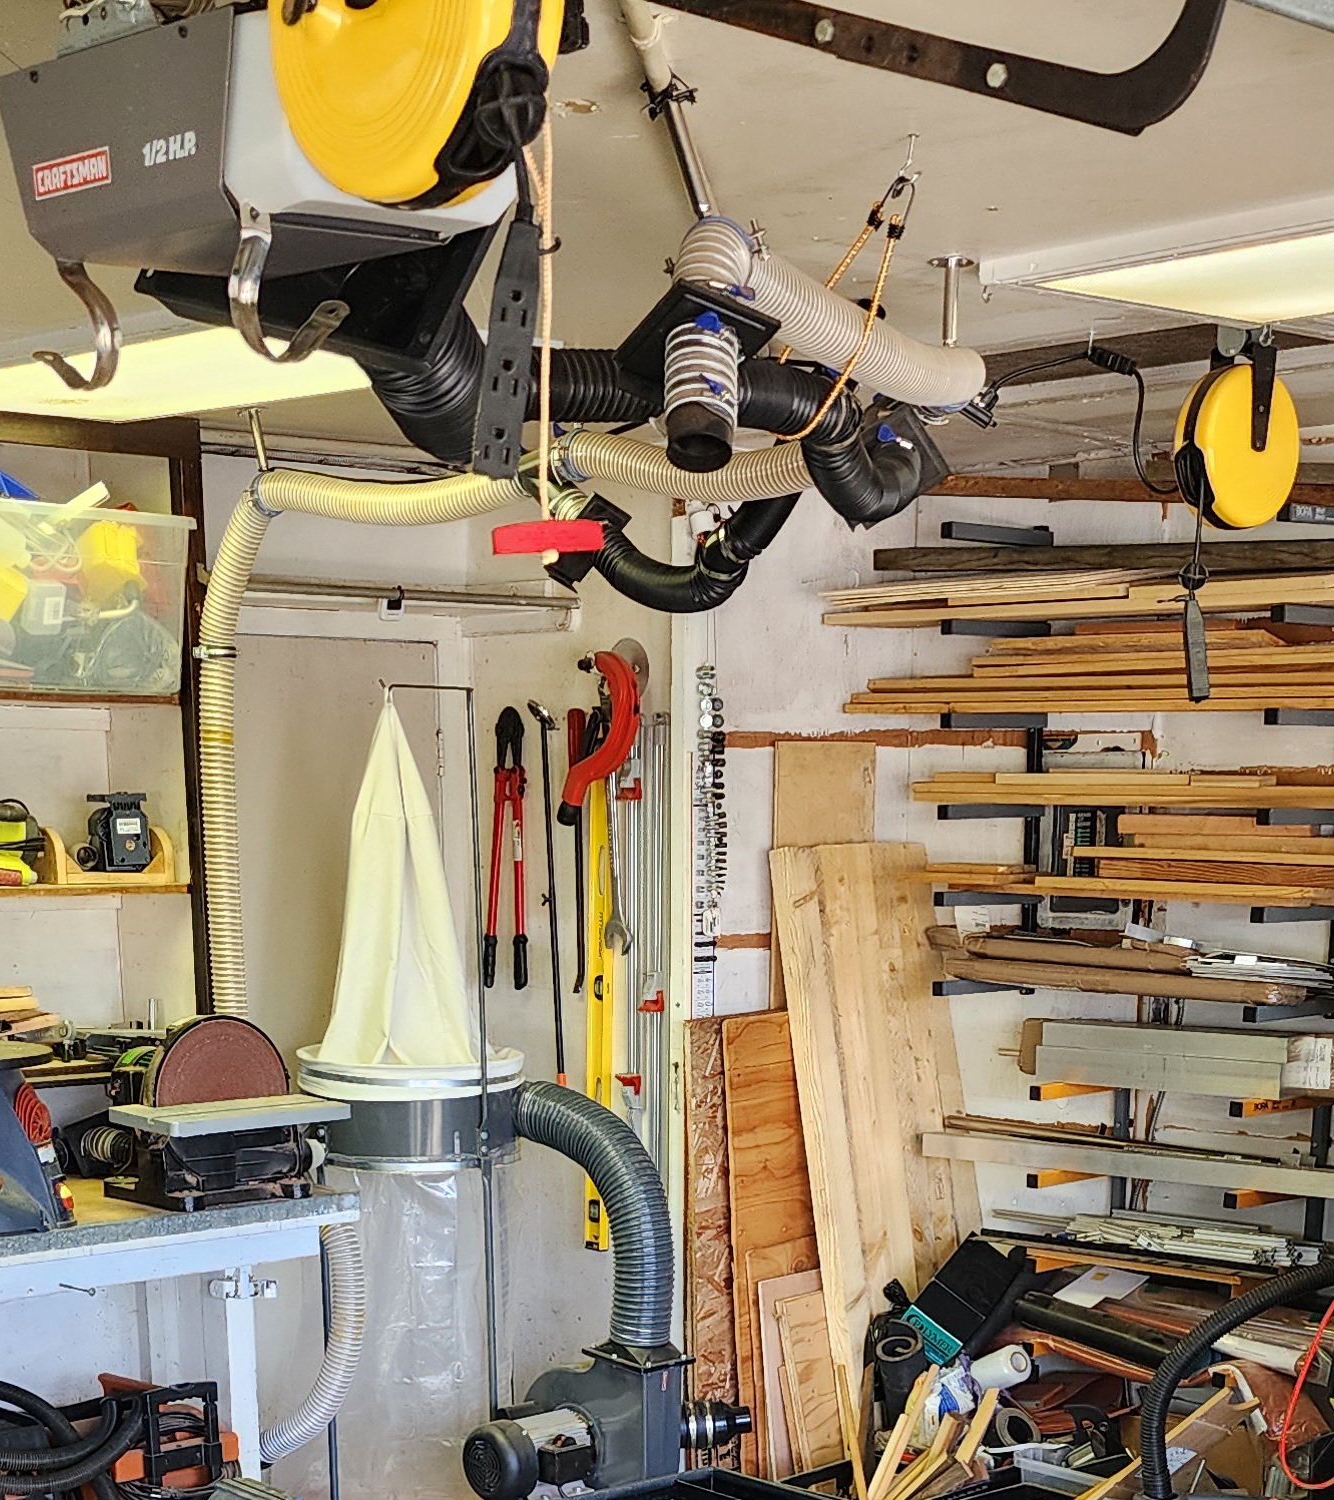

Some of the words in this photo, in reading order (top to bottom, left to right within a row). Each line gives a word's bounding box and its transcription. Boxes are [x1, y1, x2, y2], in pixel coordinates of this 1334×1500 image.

[142, 139, 167, 167] 1/2
[168, 131, 197, 161] H.P.
[36, 154, 108, 194] CRAFTSMAN
